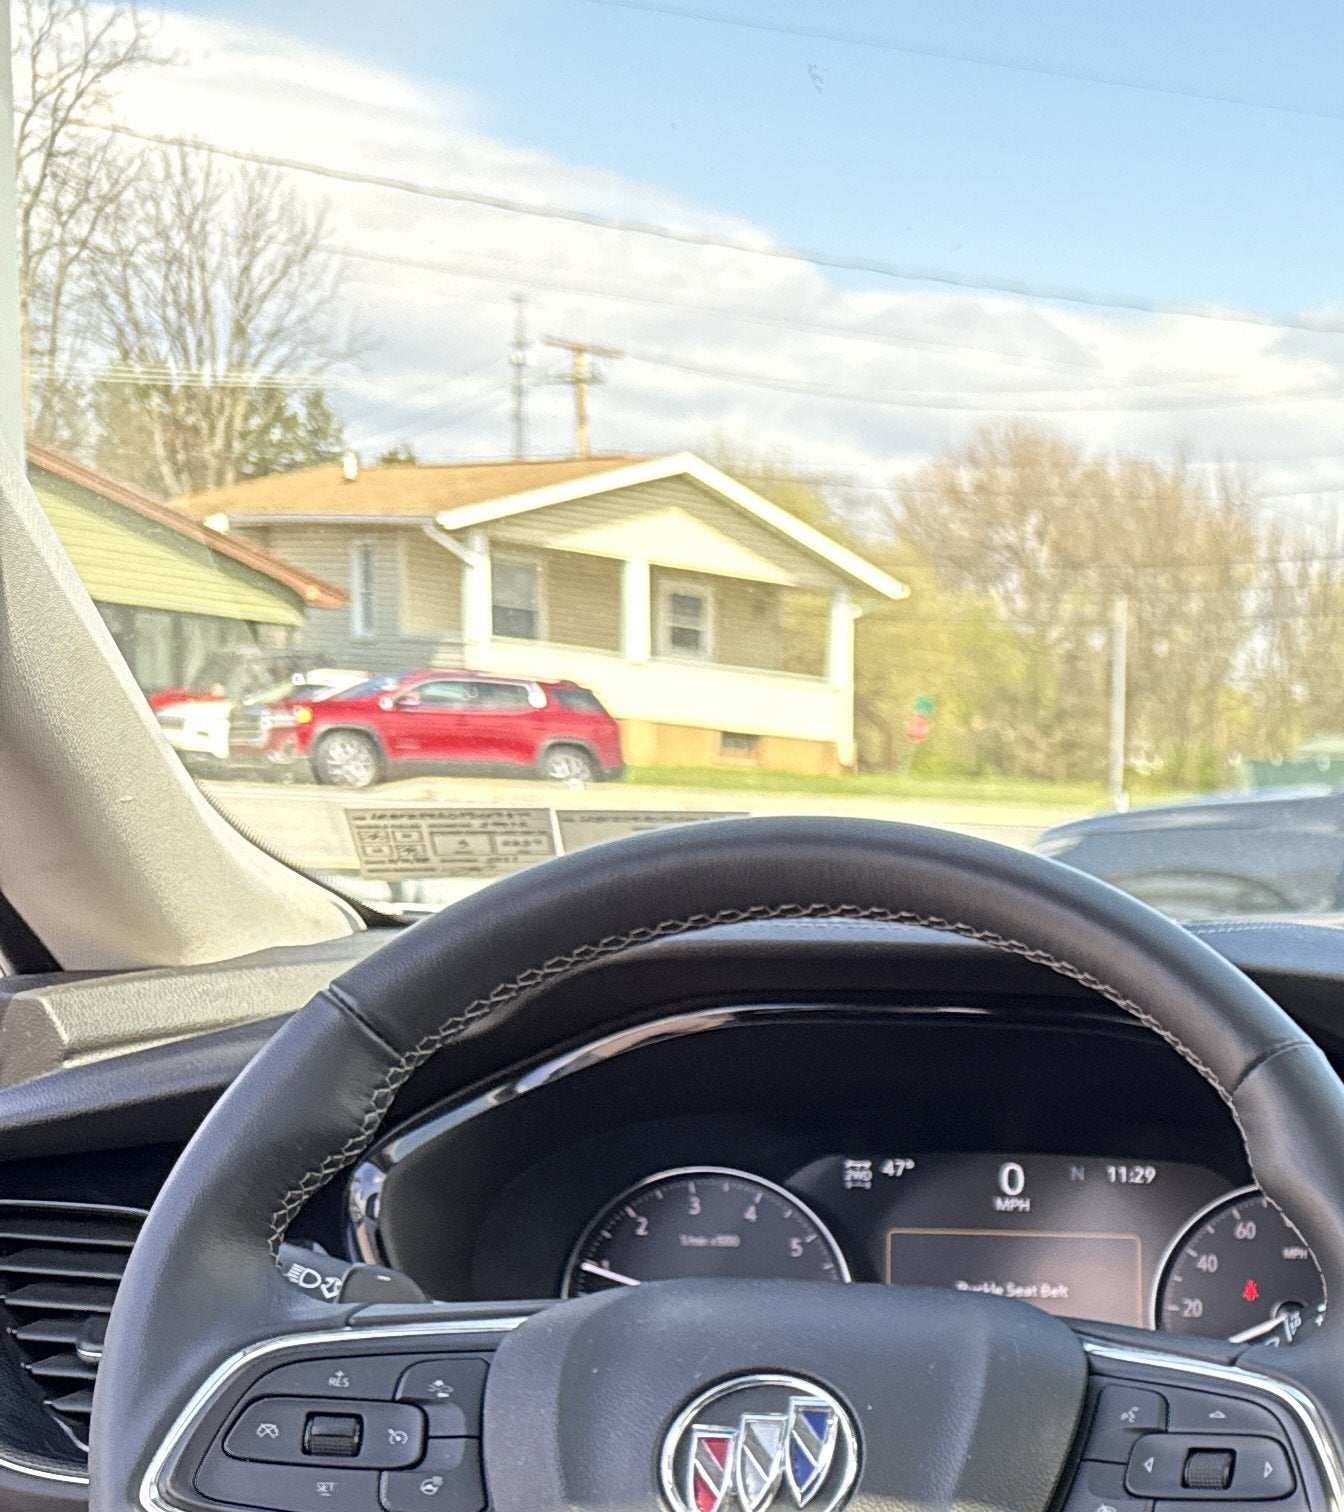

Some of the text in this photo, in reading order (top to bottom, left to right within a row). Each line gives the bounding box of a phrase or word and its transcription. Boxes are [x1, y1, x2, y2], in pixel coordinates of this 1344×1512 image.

[880, 1158, 915, 1177] 47°
[1105, 1165, 1156, 1184] 11:29
[1000, 1162, 1025, 1196] 0
[688, 1195, 701, 1216] 3
[744, 1205, 758, 1223] 4
[994, 1197, 1031, 1212] MPH
[635, 1216, 649, 1236] 2
[1234, 1220, 1256, 1240] 60
[790, 1237, 803, 1257] 5
[1196, 1254, 1218, 1272] 40
[1183, 1299, 1203, 1318] 20
